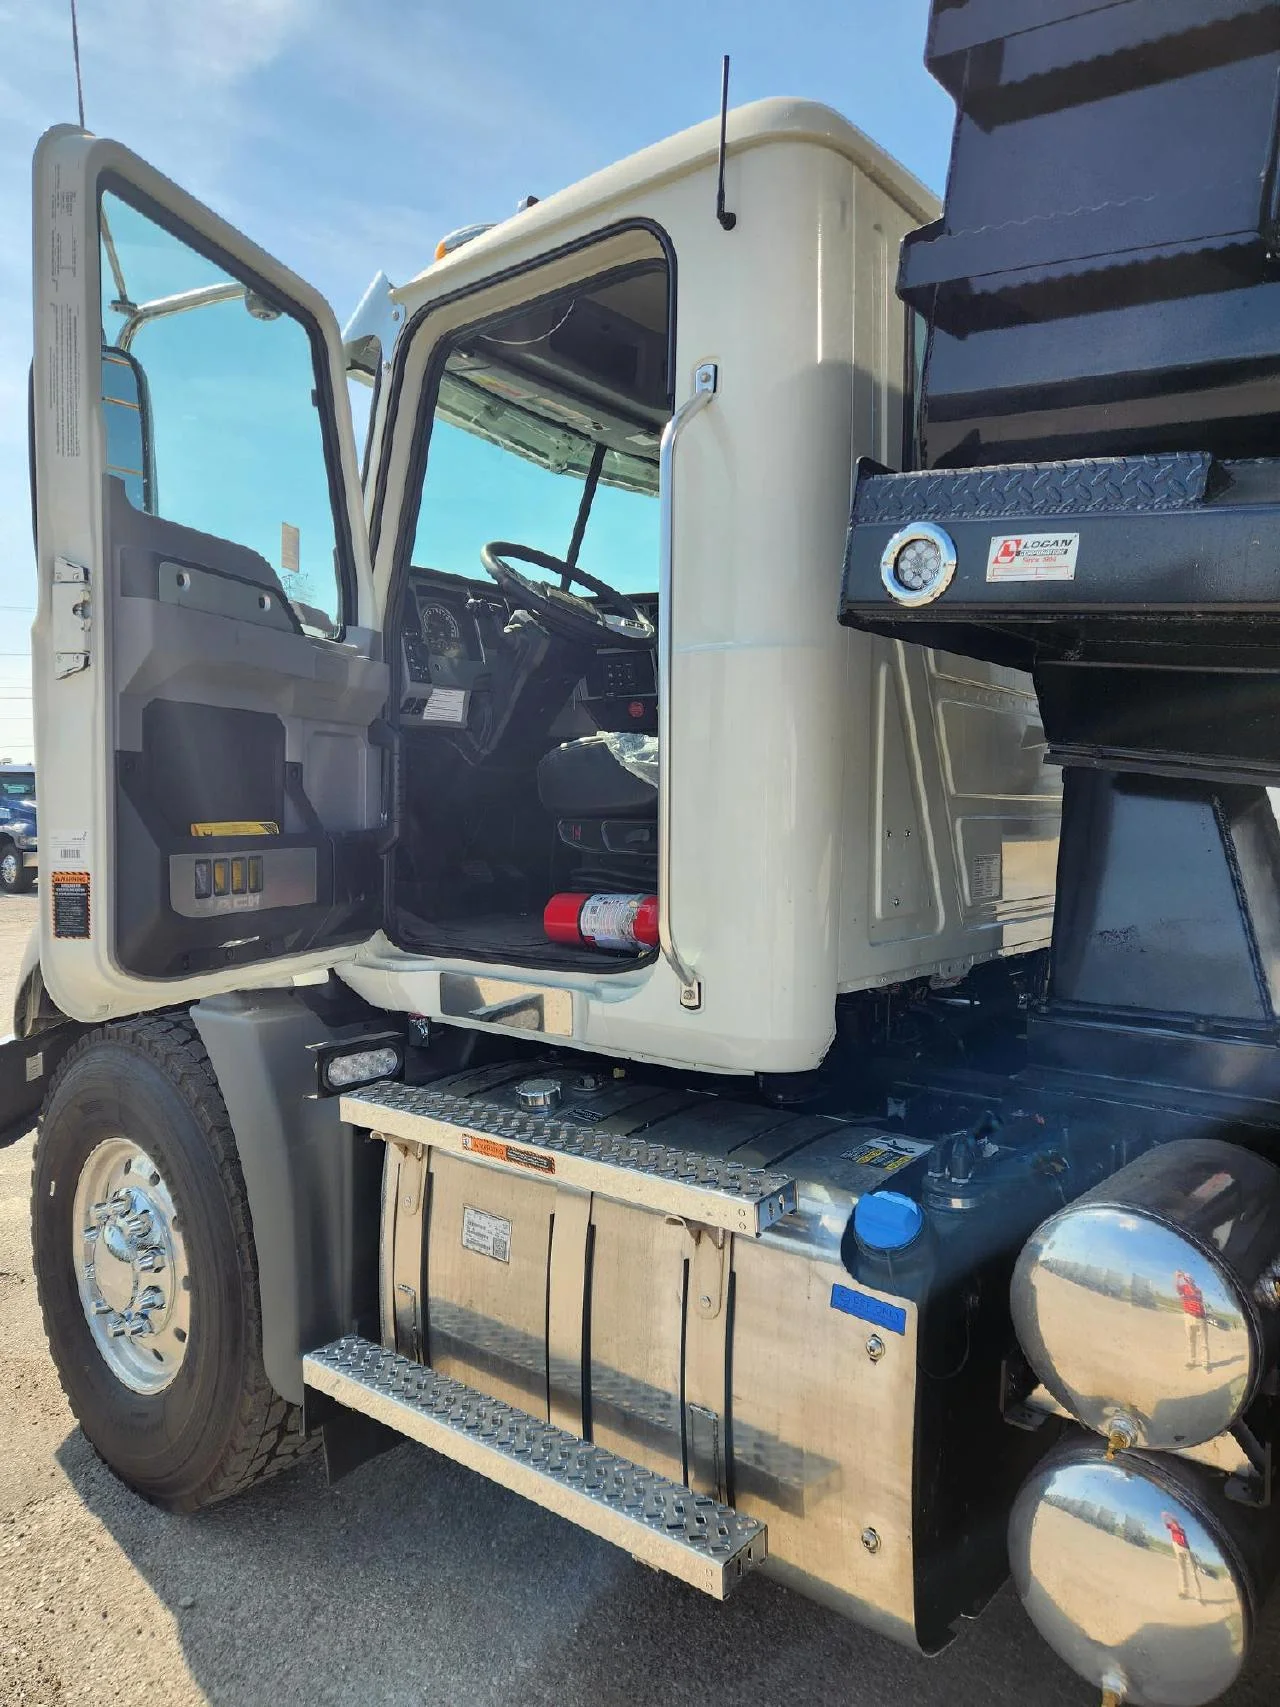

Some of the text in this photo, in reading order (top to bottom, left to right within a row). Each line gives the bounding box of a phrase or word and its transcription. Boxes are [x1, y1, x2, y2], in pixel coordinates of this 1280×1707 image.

[1023, 539, 1073, 549] LOGAN
[59, 875, 87, 883] WARNING
[479, 1142, 504, 1156] WARNING
[875, 1305, 901, 1320] ONLY
